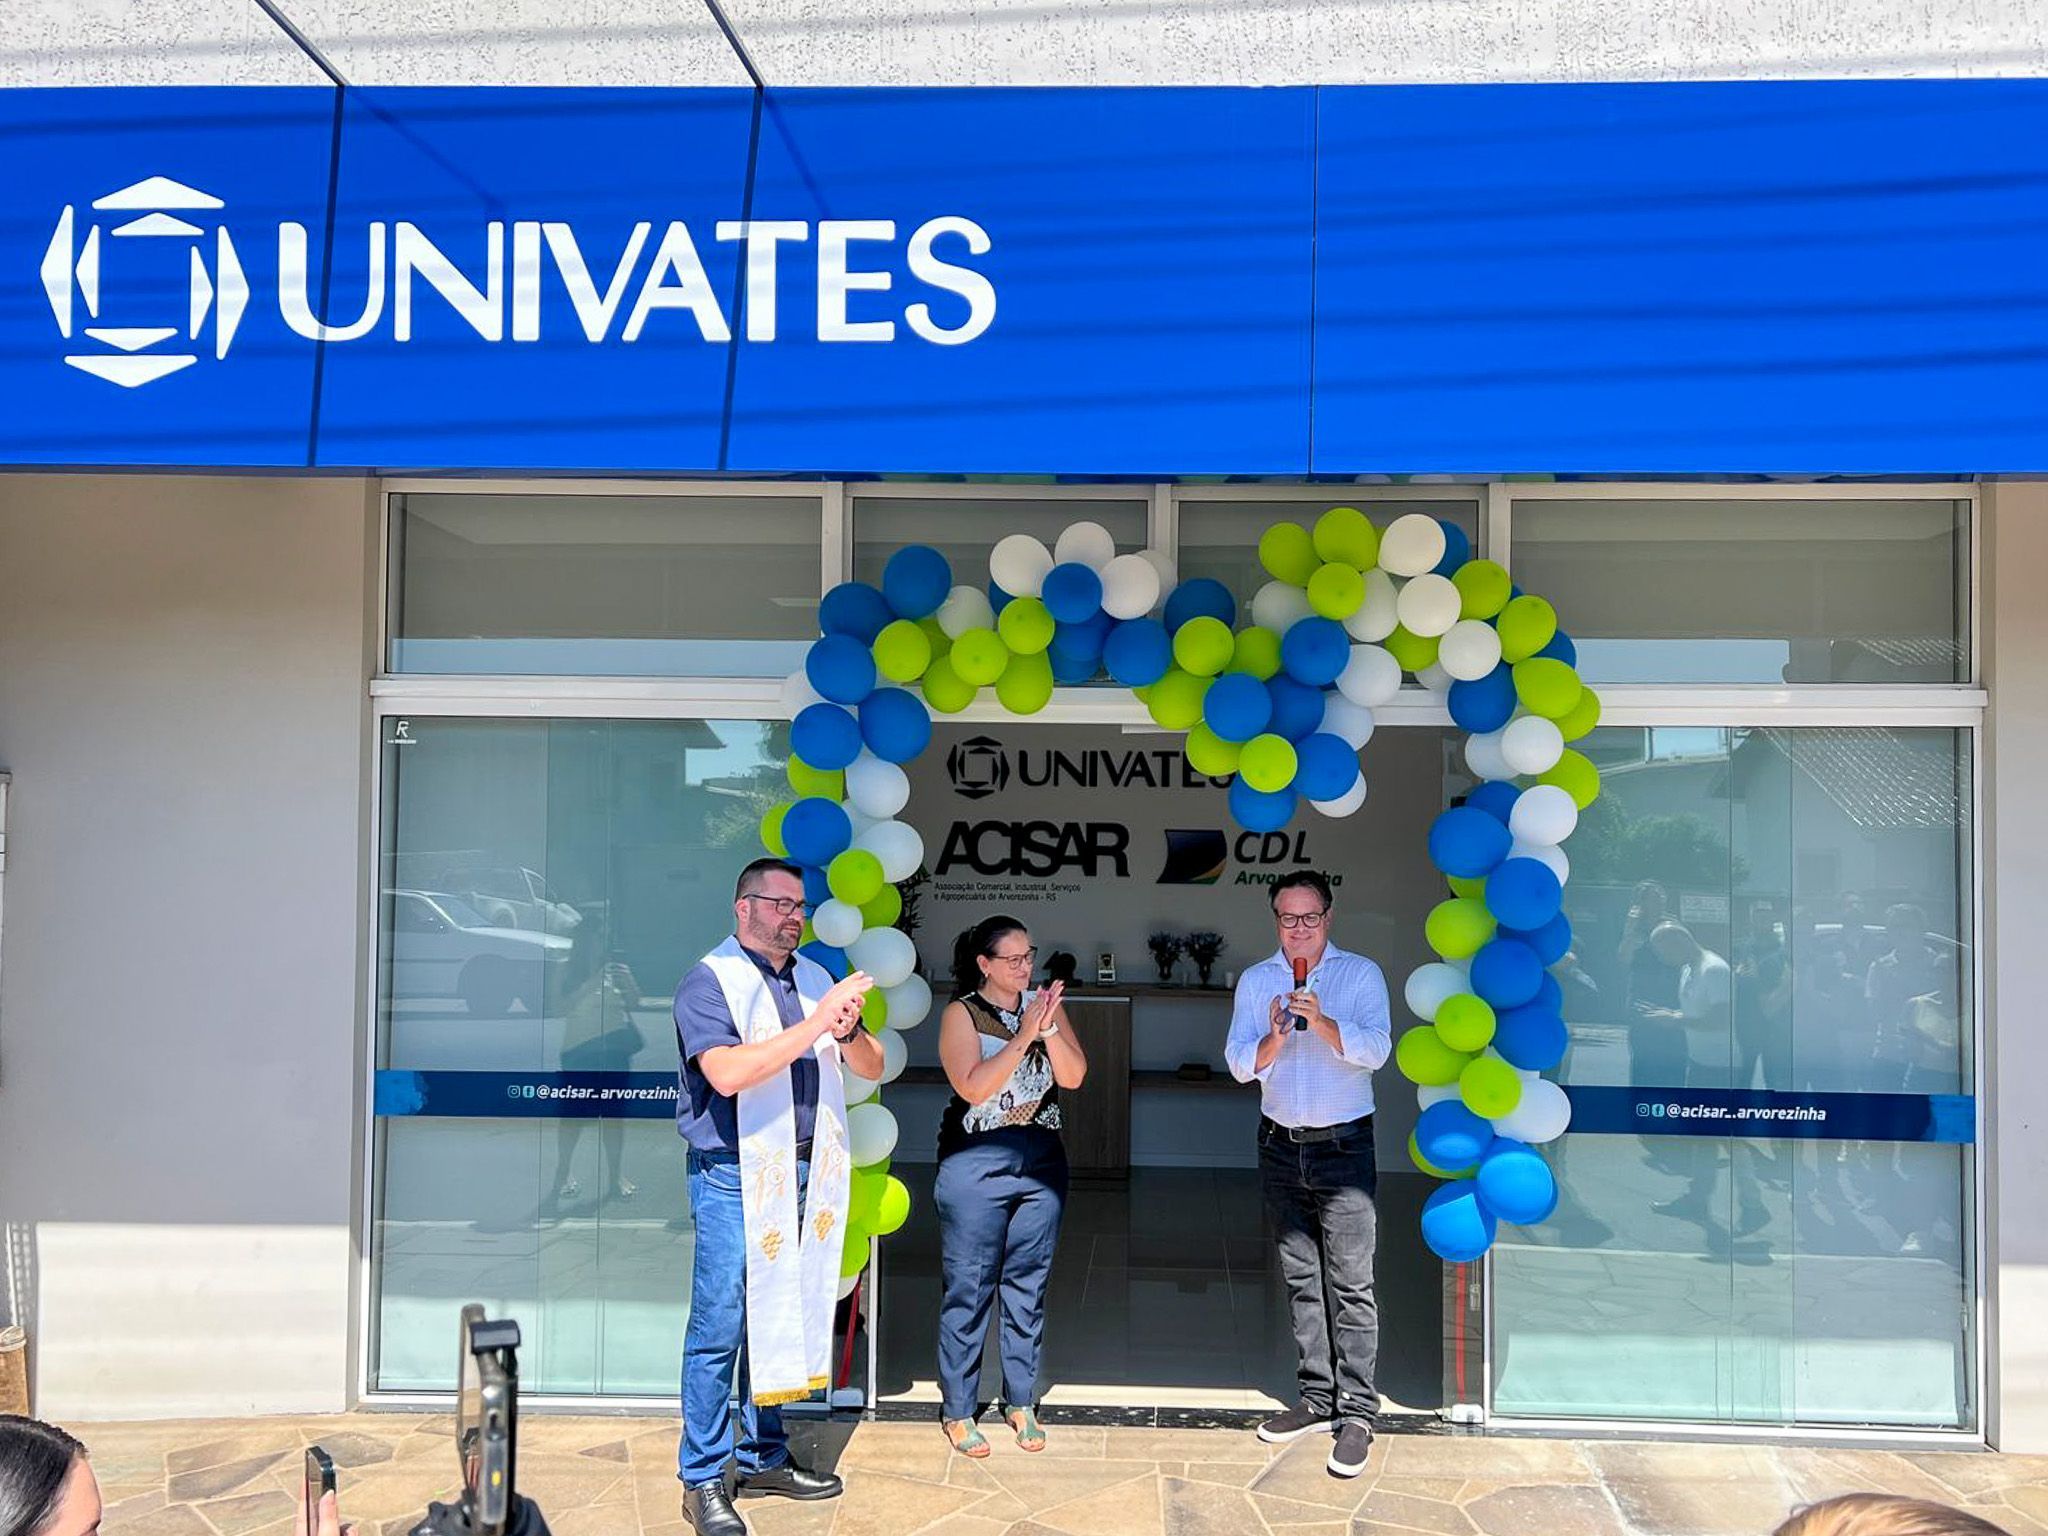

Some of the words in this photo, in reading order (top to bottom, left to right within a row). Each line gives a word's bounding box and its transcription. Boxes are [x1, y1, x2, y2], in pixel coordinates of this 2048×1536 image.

[277, 214, 998, 347] UNIVATES
[934, 820, 1131, 878] ACISAR
[1234, 830, 1312, 864] CDL
